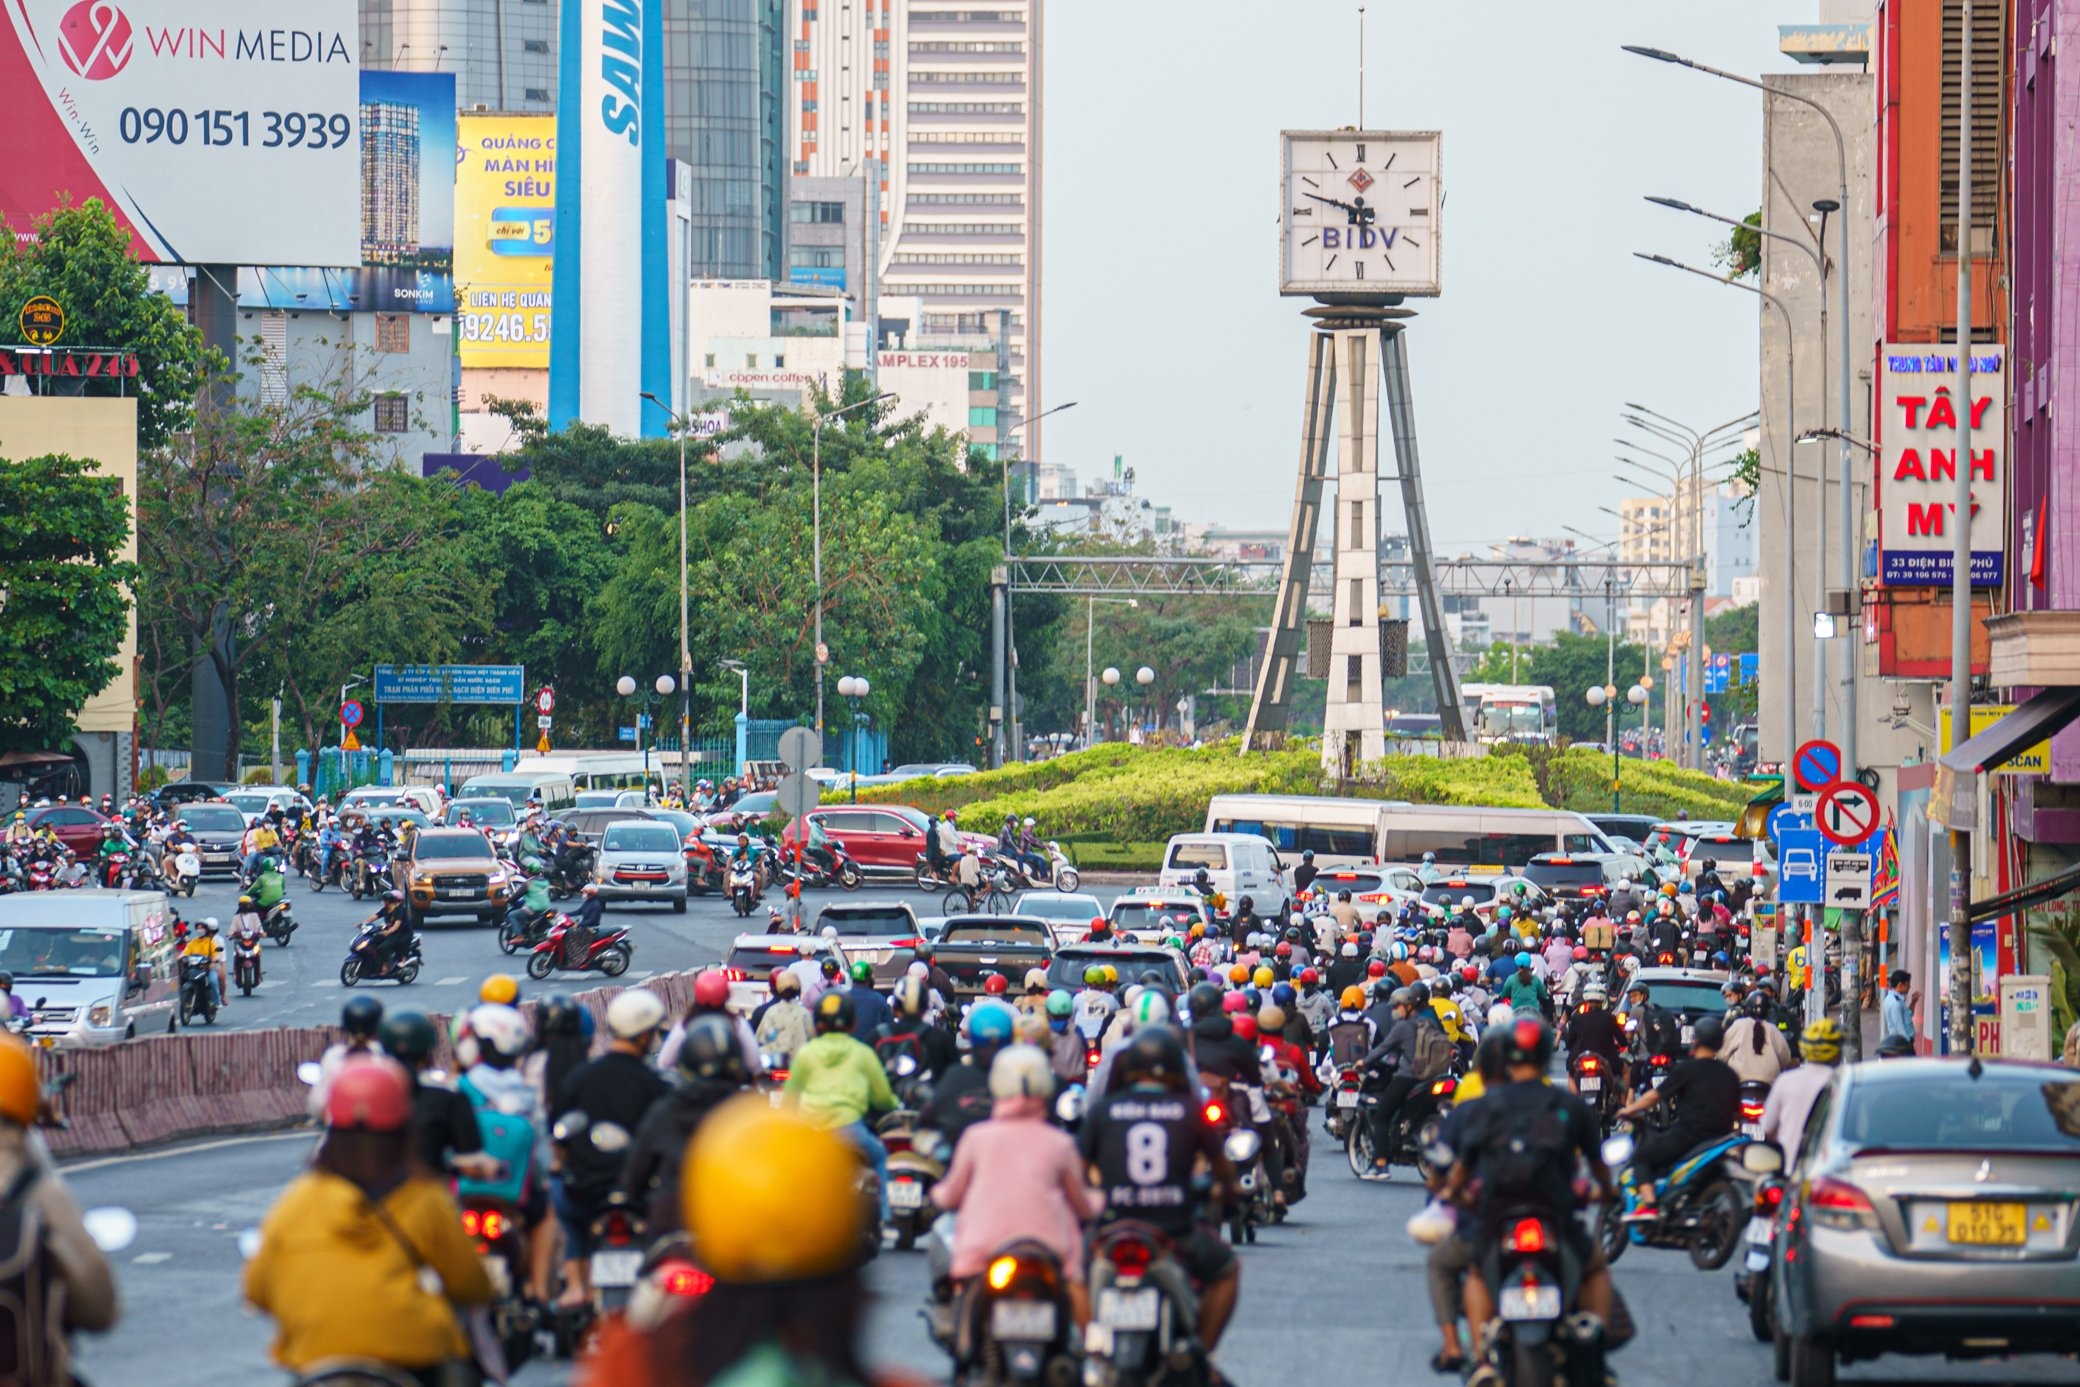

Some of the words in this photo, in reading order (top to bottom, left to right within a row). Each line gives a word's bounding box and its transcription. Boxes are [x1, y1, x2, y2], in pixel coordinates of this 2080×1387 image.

[145, 26, 225, 60] WIN
[236, 29, 351, 64] MEDIA
[59, 86, 100, 155] Win-Win
[119, 106, 188, 146] 090
[194, 109, 249, 147] 151
[262, 111, 351, 150] 3939
[504, 176, 551, 197] SIÊU
[1322, 226, 1399, 250] BIDV
[394, 287, 434, 299] SONKIM
[501, 291, 516, 309] HỆ
[459, 312, 551, 342] 9246.5
[85, 352, 140, 377] 245
[942, 354, 969, 368] 195
[1888, 355, 1922, 372] TRUNG
[1923, 353, 1945, 372] TÂM
[729, 372, 769, 385] copen
[772, 371, 813, 382] coffee
[1893, 448, 1995, 482] ANH
[1891, 557, 1905, 568] 33
[1908, 556, 1936, 570] ĐIỆN
[1970, 556, 1994, 569] PHỦ
[1902, 571, 1913, 579] 39
[2007, 754, 2042, 768] SCAN
[1125, 1121, 1169, 1187] 8
